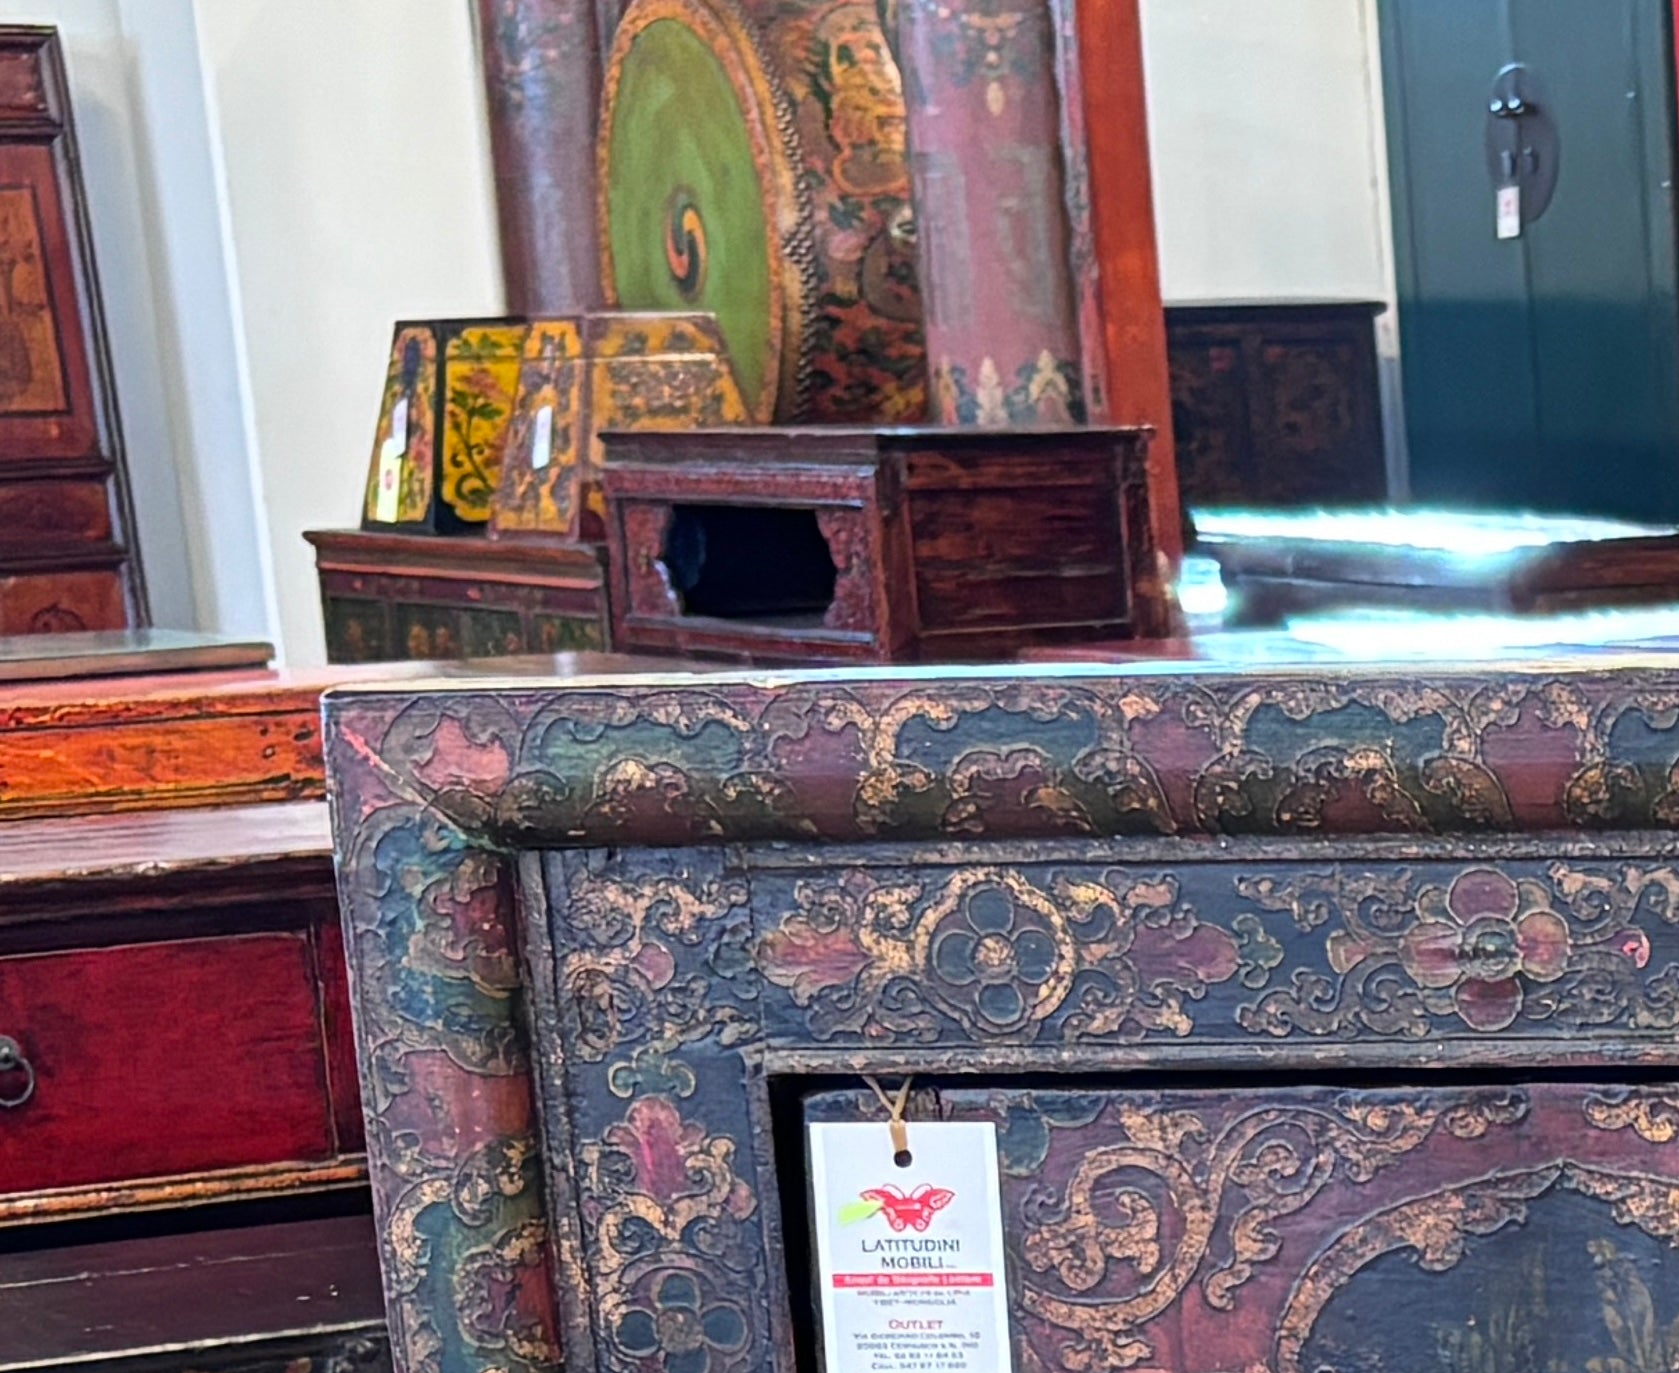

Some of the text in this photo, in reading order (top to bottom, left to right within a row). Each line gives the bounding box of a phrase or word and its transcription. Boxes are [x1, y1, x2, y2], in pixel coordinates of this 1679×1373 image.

[861, 1239, 960, 1252] LATITUDINI
[881, 1256, 943, 1269] MOBILI
[888, 1319, 943, 1330] OUTLET
